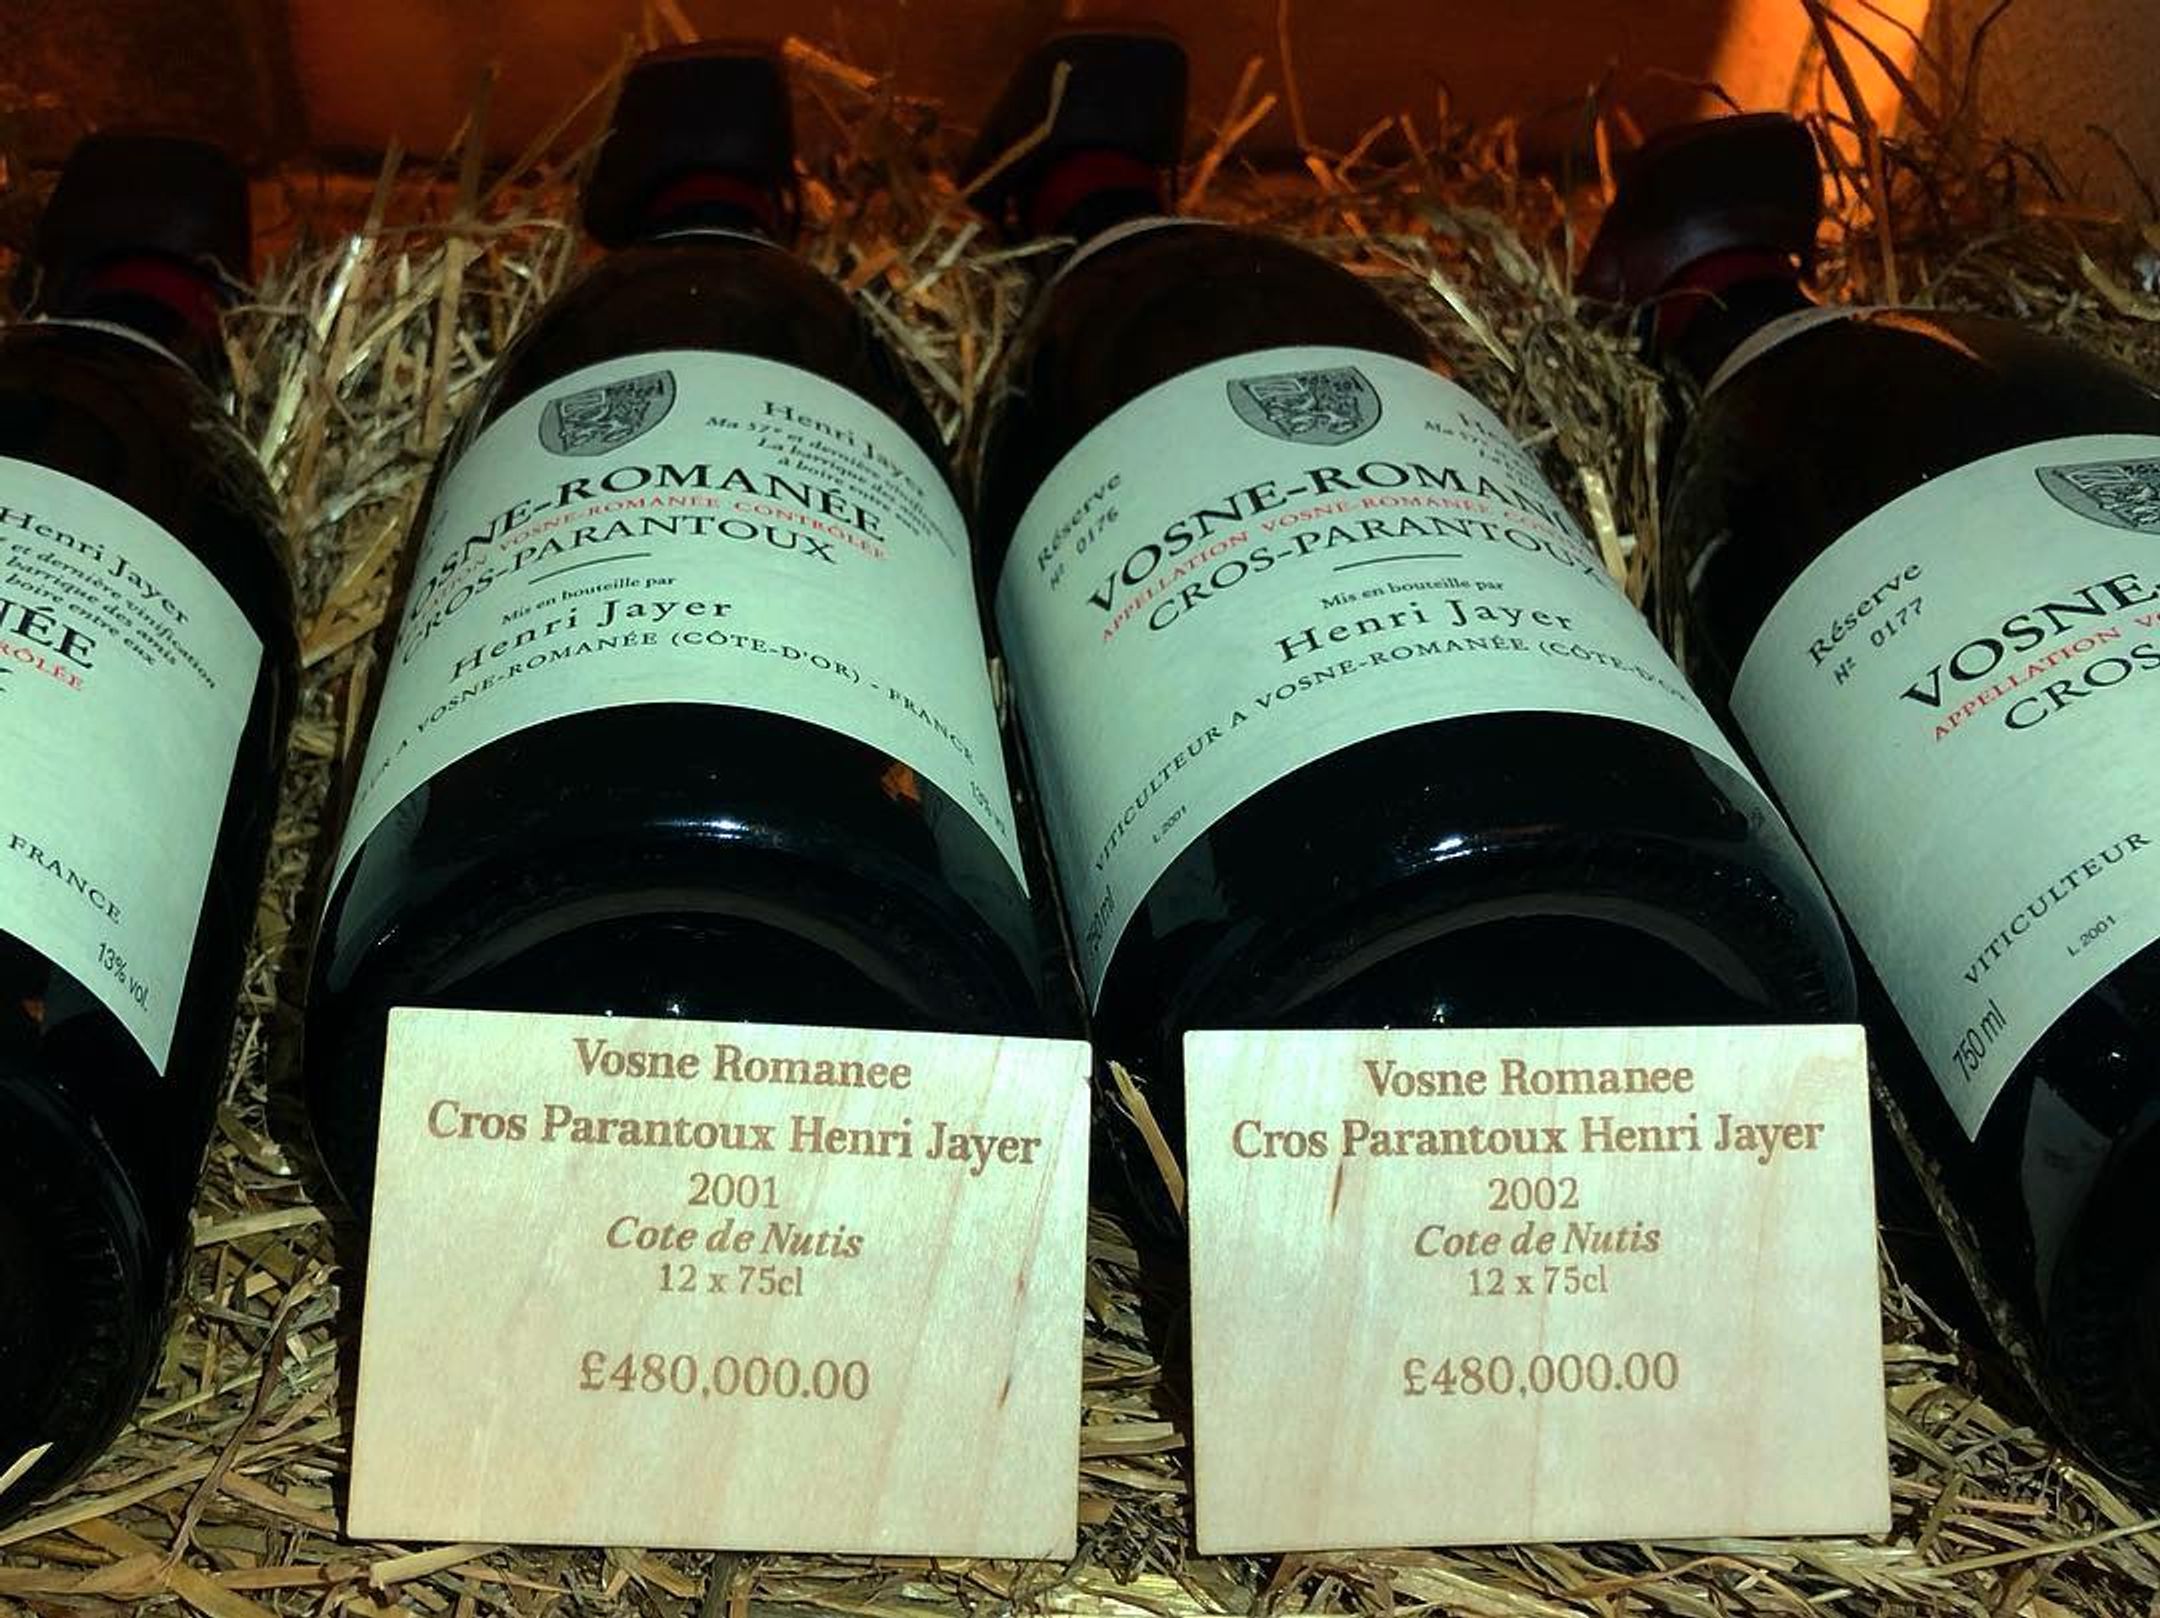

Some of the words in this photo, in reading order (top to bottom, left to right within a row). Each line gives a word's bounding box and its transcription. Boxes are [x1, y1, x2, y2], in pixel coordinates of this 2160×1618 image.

[705, 416, 739, 429] Ma
[764, 401, 855, 446] Henri
[790, 444, 869, 484] barrique
[796, 461, 844, 485] boire
[1076, 506, 1118, 554] 0176
[0, 507, 106, 561] Henri
[108, 554, 190, 624] Jayer
[1102, 531, 1250, 642] APPELLATION
[5, 556, 100, 605] barrique
[103, 603, 133, 628] des
[136, 629, 177, 666] amis
[11, 543, 31, 554] et
[37, 551, 122, 600] dernière
[126, 601, 216, 689] vinification
[501, 606, 531, 626] Mis
[536, 597, 557, 609] en
[562, 578, 641, 602] bouteille
[644, 576, 678, 589] par
[1321, 591, 1357, 609] Mis
[1362, 586, 1384, 599] en
[1389, 577, 1472, 595] bouteille
[1476, 580, 1504, 593] par
[1807, 563, 1922, 668] Réserve
[5, 573, 64, 605] boire
[69, 603, 120, 637] entre
[123, 637, 156, 666] eux
[450, 607, 579, 683] Henri
[597, 599, 732, 628] Jayer
[1274, 601, 1431, 664] Henri
[1445, 598, 1575, 632] Jayer
[1870, 596, 1923, 648] 0177
[1900, 574, 2160, 709] VOSNE
[418, 632, 657, 732] VOSNE-ROMANÉE
[671, 630, 860, 684] (CÔTE-D'OR)
[1933, 626, 2121, 742] APPELLATION
[1095, 726, 1223, 871] VITICULTEUR
[1230, 710, 1249, 729] A
[1255, 636, 1529, 709] VOSNE-ROMANÉE
[9, 834, 121, 924] FRANCE
[1964, 833, 2151, 985] VITICULTEUR
[99, 943, 127, 983] 13%
[572, 1037, 700, 1081] Vosne
[713, 1044, 912, 1089] Romanee
[1952, 1027, 1986, 1083] 750
[1981, 998, 2007, 1043] ml
[1364, 1058, 1487, 1098] Vosne
[1500, 1058, 1695, 1097] Romanee
[428, 1100, 527, 1142] Cros
[541, 1104, 774, 1151] Parantoux
[789, 1116, 912, 1159] Henri
[927, 1121, 1041, 1176] Jayer
[1232, 1120, 1328, 1160] Cros
[1342, 1119, 1568, 1158] Parantoux
[1581, 1113, 1703, 1152] Henri
[1713, 1113, 1825, 1165] Jayer
[688, 1172, 781, 1210] 2001
[1487, 1177, 1580, 1212] 2002
[606, 1215, 698, 1253] Cote
[706, 1218, 754, 1255] de
[762, 1221, 864, 1259] Nutis
[1414, 1224, 1498, 1258] Cote
[1510, 1221, 1553, 1255] de
[1563, 1220, 1661, 1255] Nutis
[658, 1264, 698, 1293] 12
[707, 1271, 730, 1294] x
[737, 1266, 803, 1298] 75cl
[1468, 1268, 1506, 1297] 12
[1514, 1275, 1534, 1295] x
[1541, 1266, 1609, 1296] 75cl
[580, 1350, 871, 1401] £480,000.00
[1403, 1351, 1680, 1400] £480,000.00
